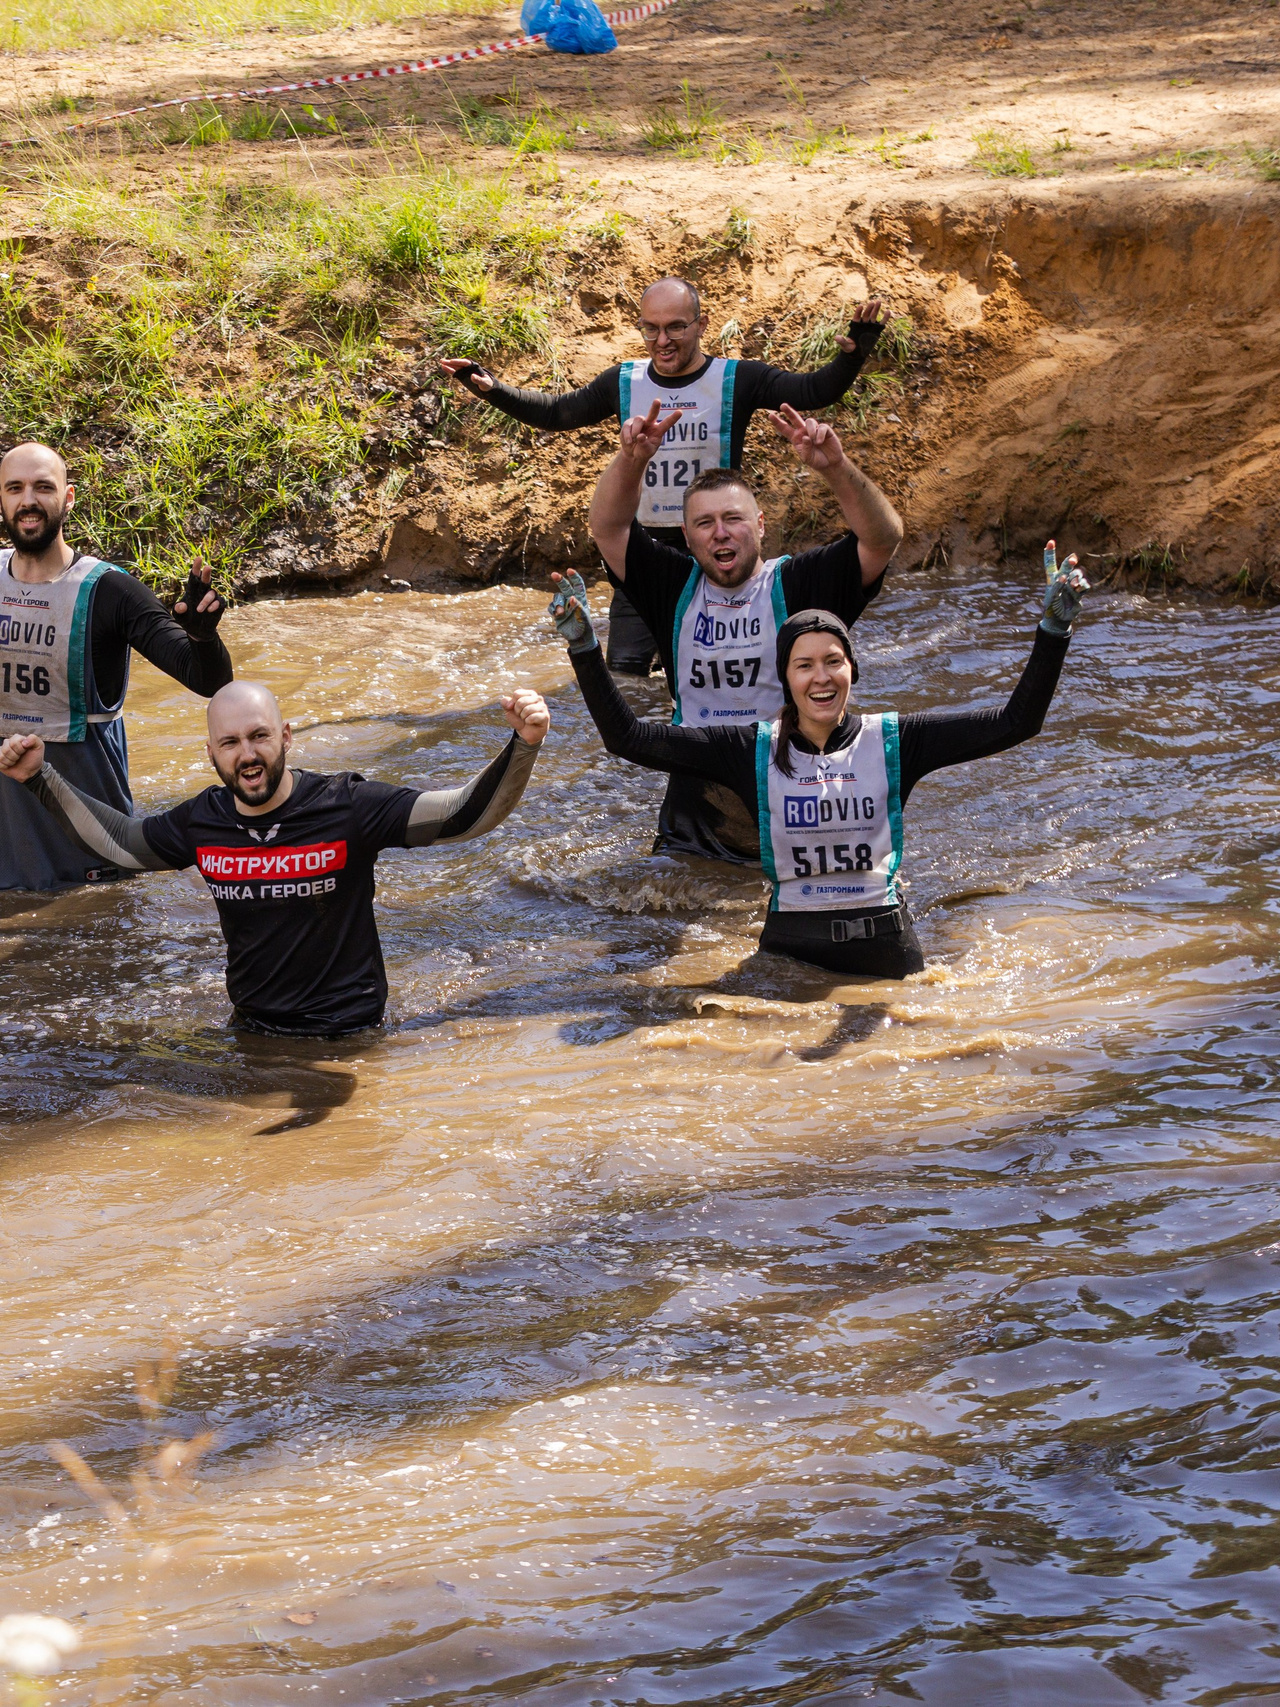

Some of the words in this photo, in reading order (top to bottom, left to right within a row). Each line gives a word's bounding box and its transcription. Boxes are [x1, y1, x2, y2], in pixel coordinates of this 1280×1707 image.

[667, 421, 708, 443] DVIG
[644, 459, 700, 488] 6121
[23, 598, 50, 607] ГЕРОЕВ
[694, 617, 761, 645] RODVIG
[689, 657, 762, 689] 5157
[2, 712, 44, 723] ГАЗПРОМБАНК
[712, 708, 758, 717] ГАЗПРОМБАНК
[787, 796, 875, 824] RODVIG
[201, 849, 336, 875] ИНСТРУКТОР
[791, 843, 873, 878] 5158
[261, 877, 336, 899] ГЕРОЕВ
[816, 884, 865, 894] ГАЗПРОМБАНК
